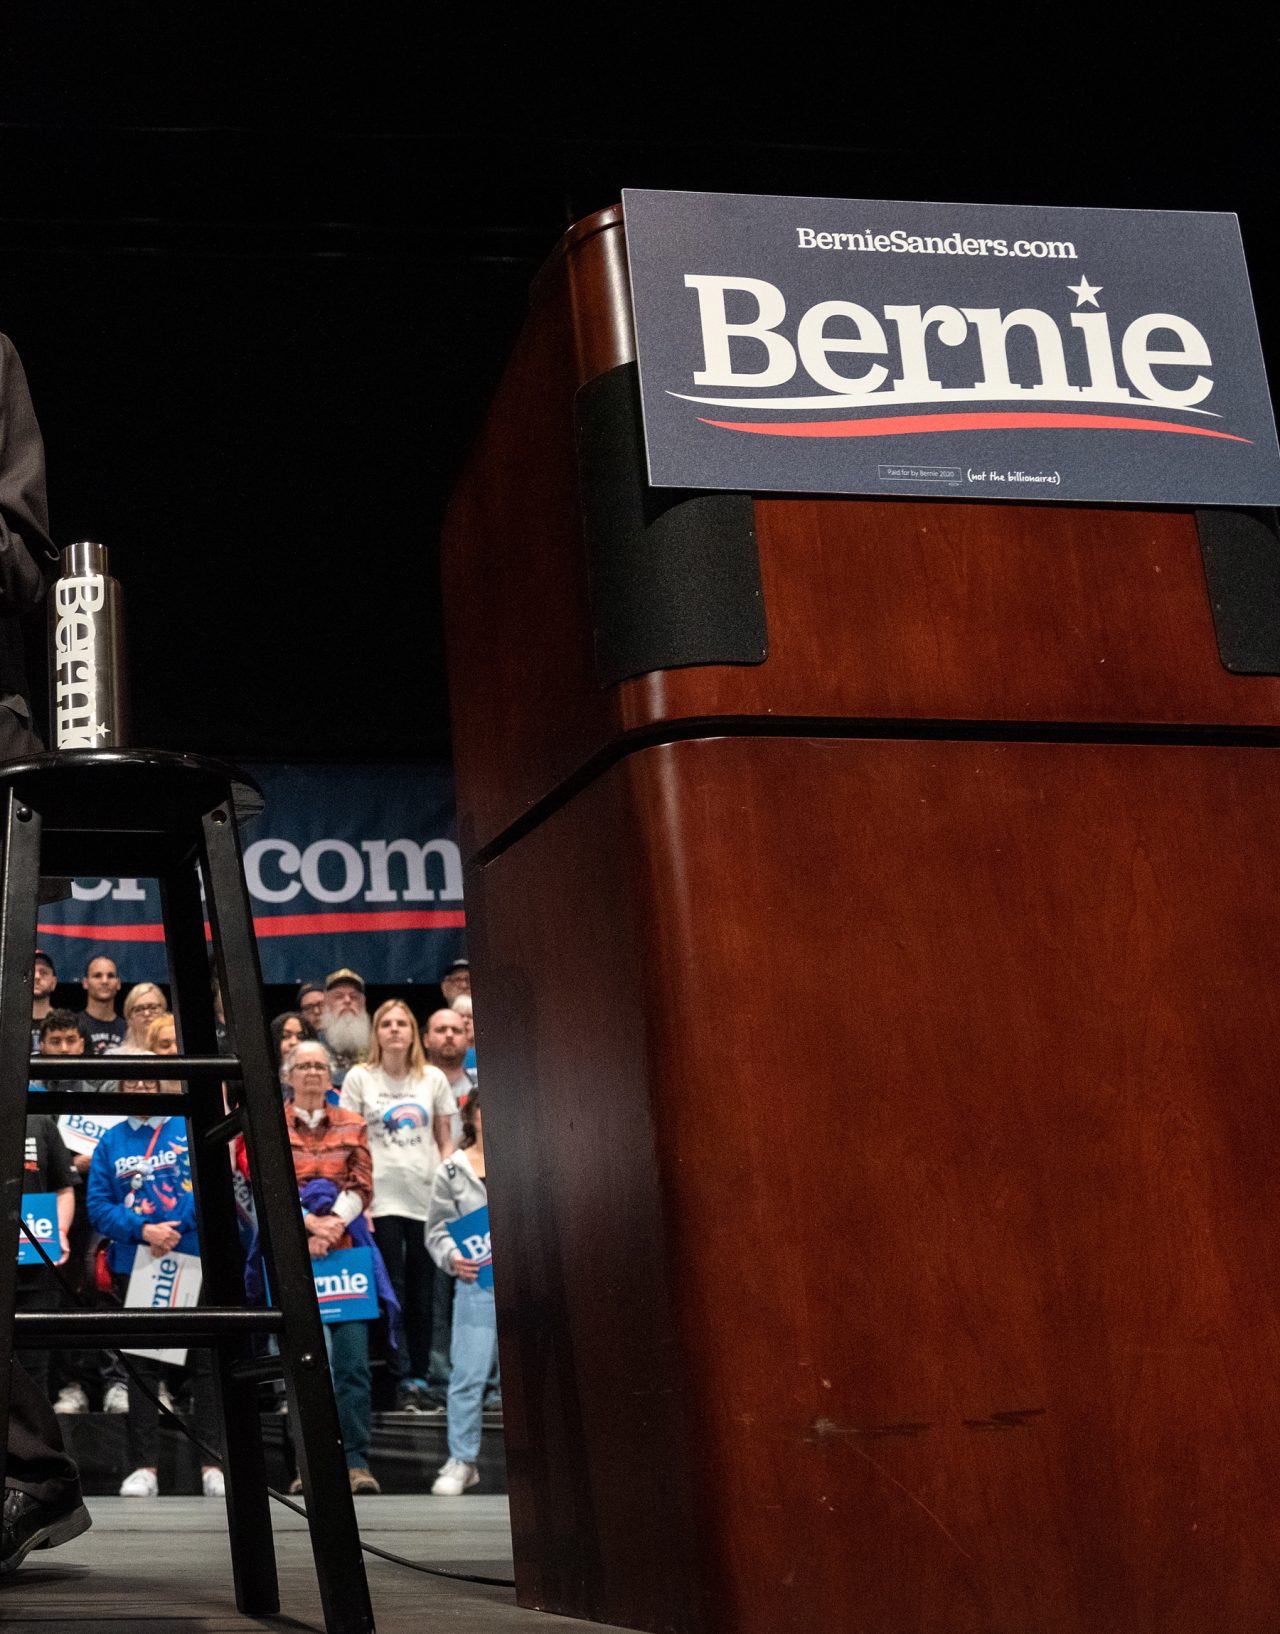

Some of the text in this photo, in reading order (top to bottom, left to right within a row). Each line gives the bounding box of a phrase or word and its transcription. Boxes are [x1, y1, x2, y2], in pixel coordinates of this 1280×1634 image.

[796, 228, 1078, 259] BernieSanders.com
[684, 274, 1215, 408] Bernie
[887, 468, 900, 476] Paid
[911, 469, 919, 477] by
[940, 470, 955, 478] 2020
[967, 468, 987, 482] (not
[989, 471, 1005, 481] the
[1007, 471, 1061, 485] billionaires)
[55, 574, 109, 749] Berni
[315, 1268, 369, 1296] rnie
